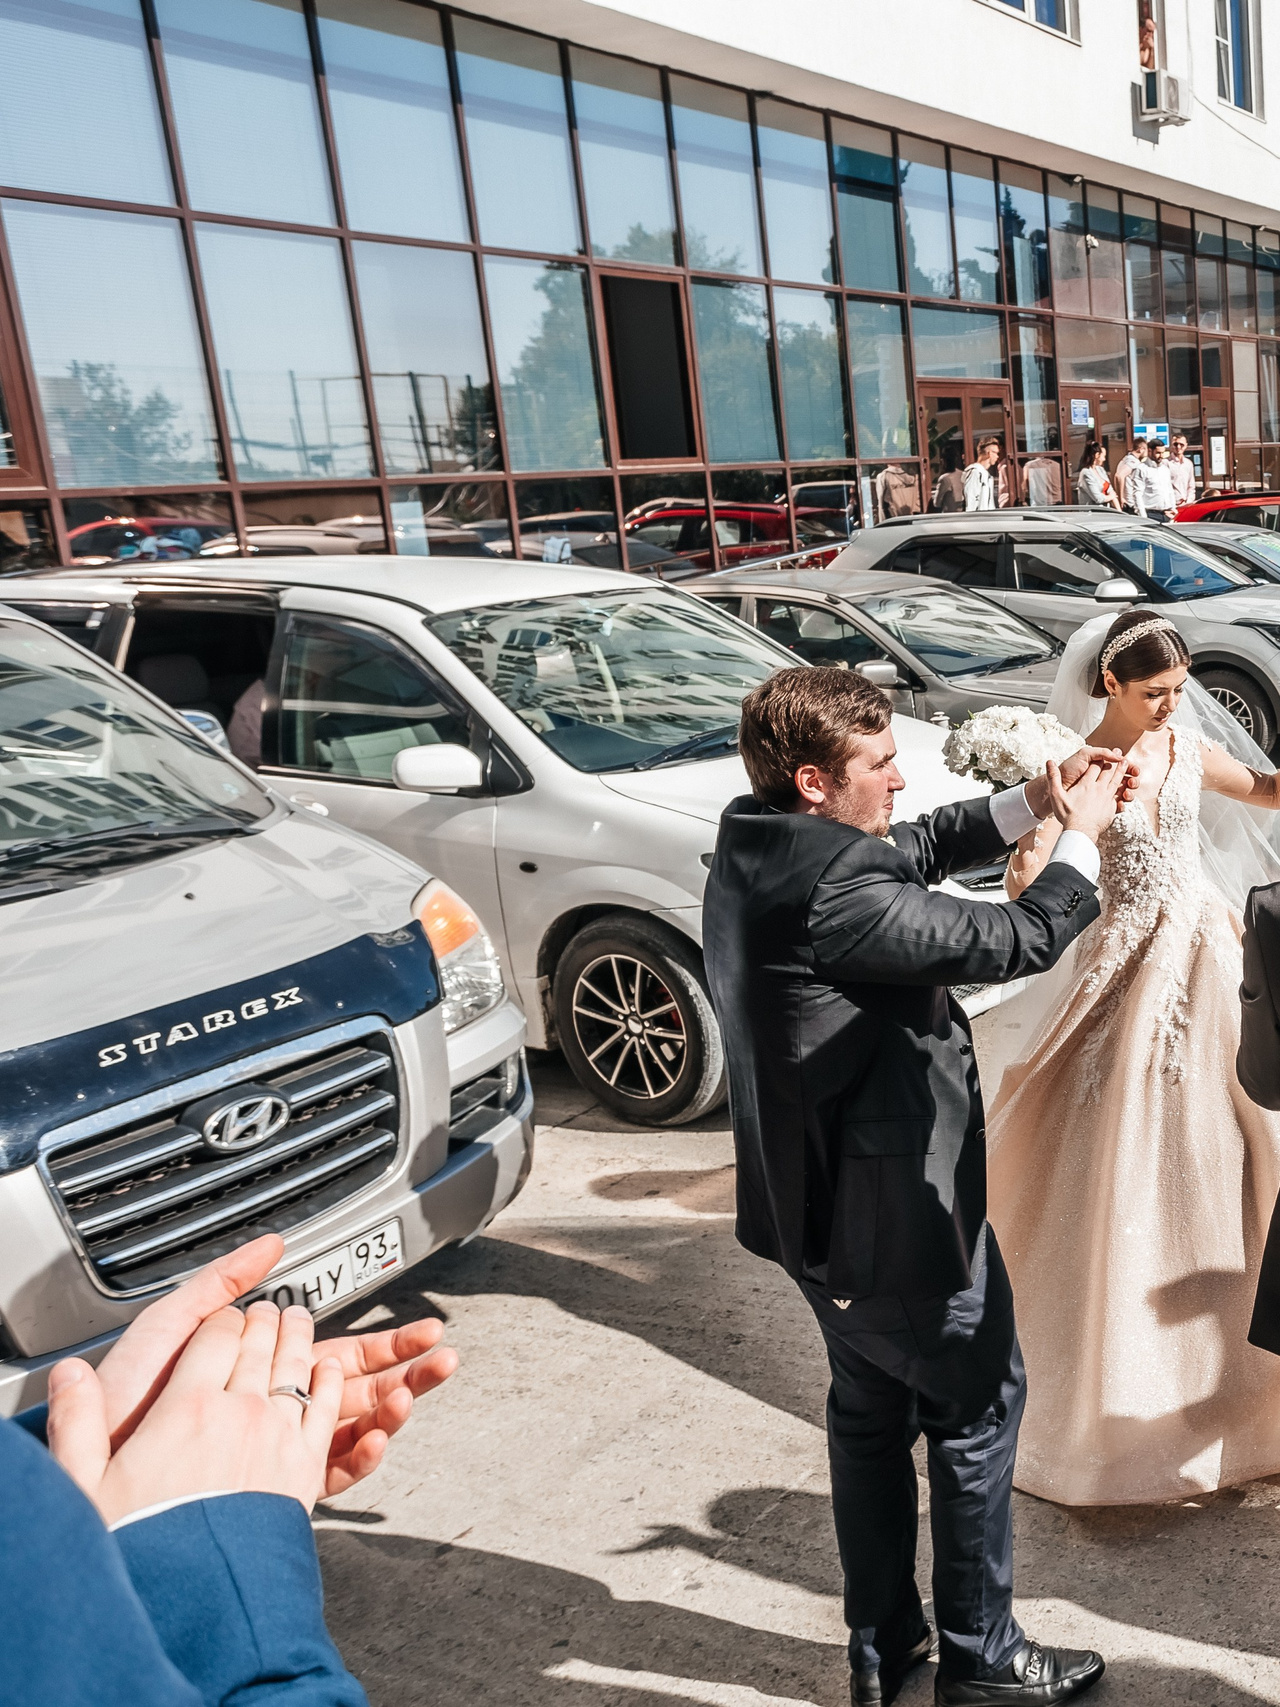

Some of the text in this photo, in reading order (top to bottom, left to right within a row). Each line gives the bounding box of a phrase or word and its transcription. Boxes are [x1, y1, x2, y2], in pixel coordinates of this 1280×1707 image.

[98, 987, 303, 1068] STAREX
[355, 1231, 388, 1269] 93
[356, 1265, 380, 1282] RUS
